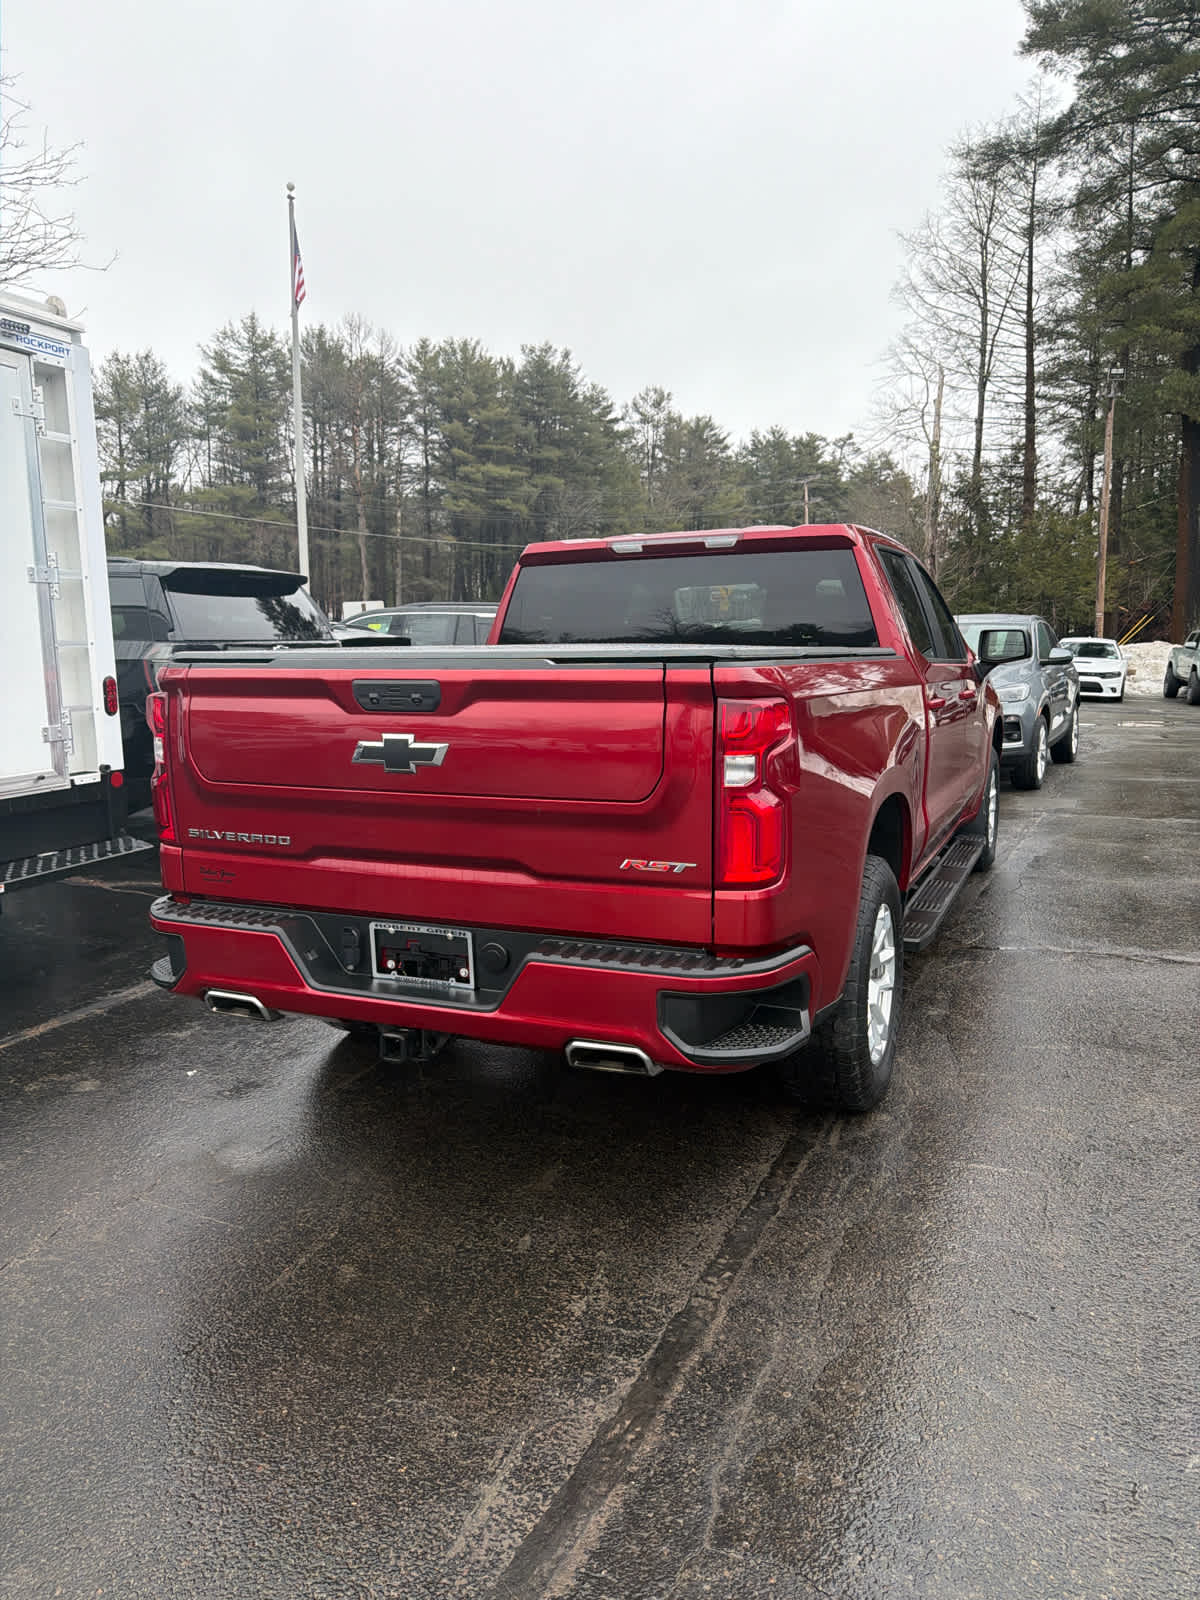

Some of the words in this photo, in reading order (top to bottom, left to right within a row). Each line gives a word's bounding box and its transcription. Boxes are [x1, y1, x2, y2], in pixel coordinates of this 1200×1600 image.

[16, 335, 71, 357] ROCKPORT
[188, 828, 291, 845] SILVERADO
[619, 858, 697, 873] RST
[374, 922, 421, 932] ROBERT
